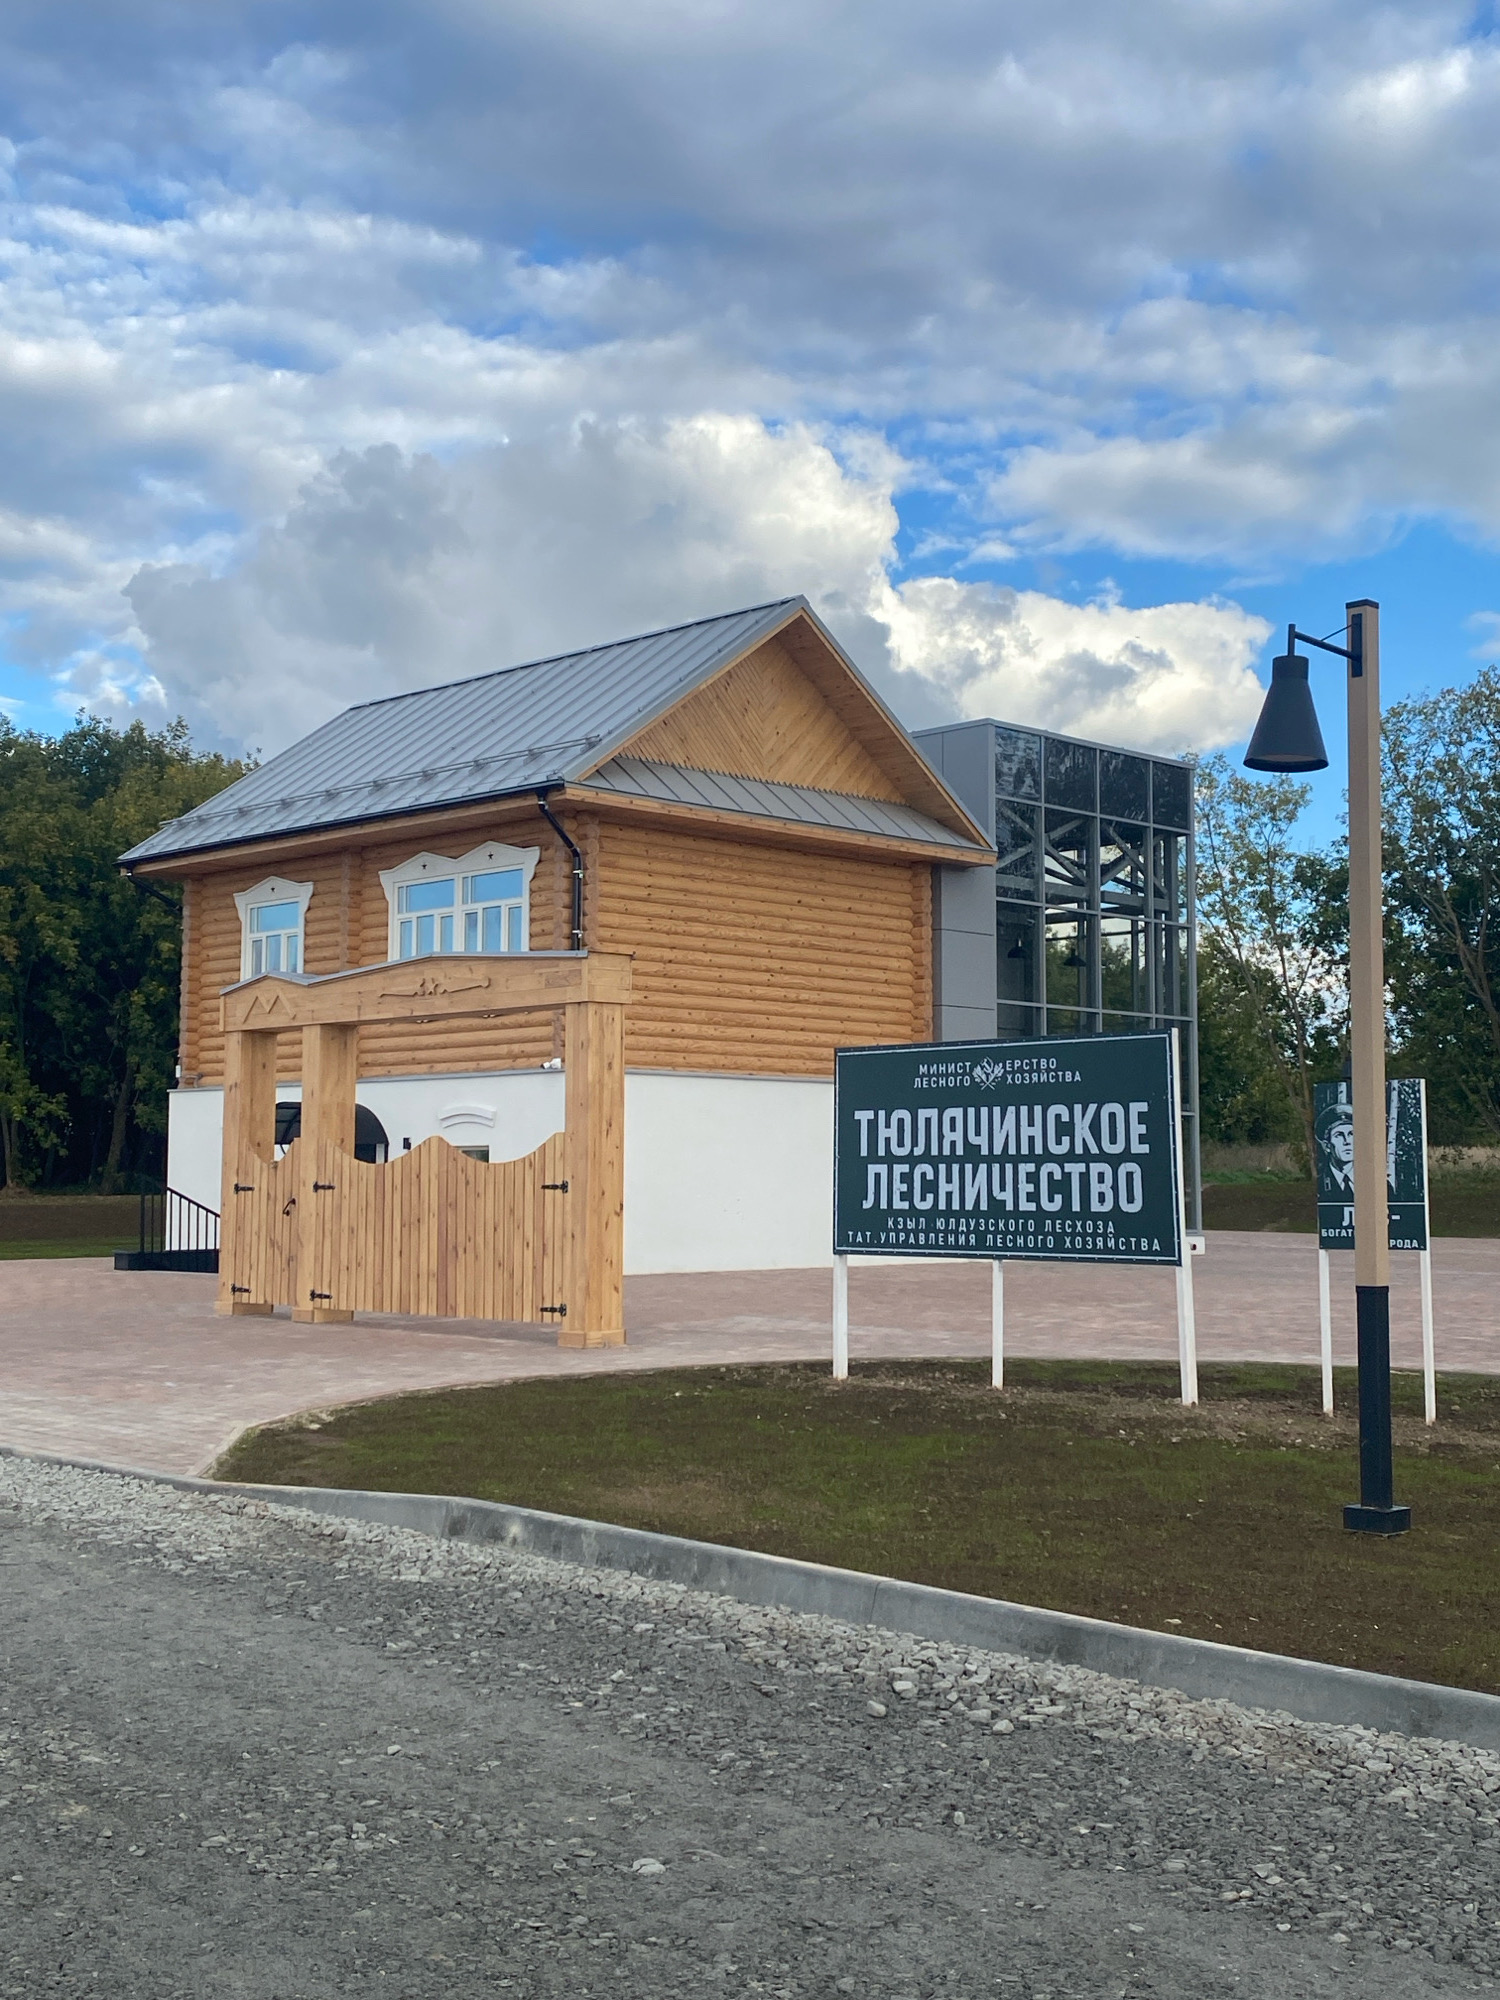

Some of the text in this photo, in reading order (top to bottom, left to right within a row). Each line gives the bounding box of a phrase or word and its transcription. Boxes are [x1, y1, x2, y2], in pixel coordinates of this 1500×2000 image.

[919, 1058, 1057, 1075] МИНИСТ ЕРСТВО
[914, 1070, 1081, 1088] ЛЕСНОГО ХОЗЯЙСТВА
[854, 1101, 1150, 1157] ТЮЛЯЧИНСКОЕ
[862, 1162, 1143, 1213] ЛЕСНИЧЕСТВО
[888, 1217, 1115, 1233] КЗЫЛ ЮЛДУЗСКОГО ЛЕСХОЗА
[986, 1234, 1054, 1248] ЛЕСНОГО
[1064, 1234, 1161, 1251] ХОЗЯЙСТВА
[1389, 1240, 1419, 1248] РОДА
